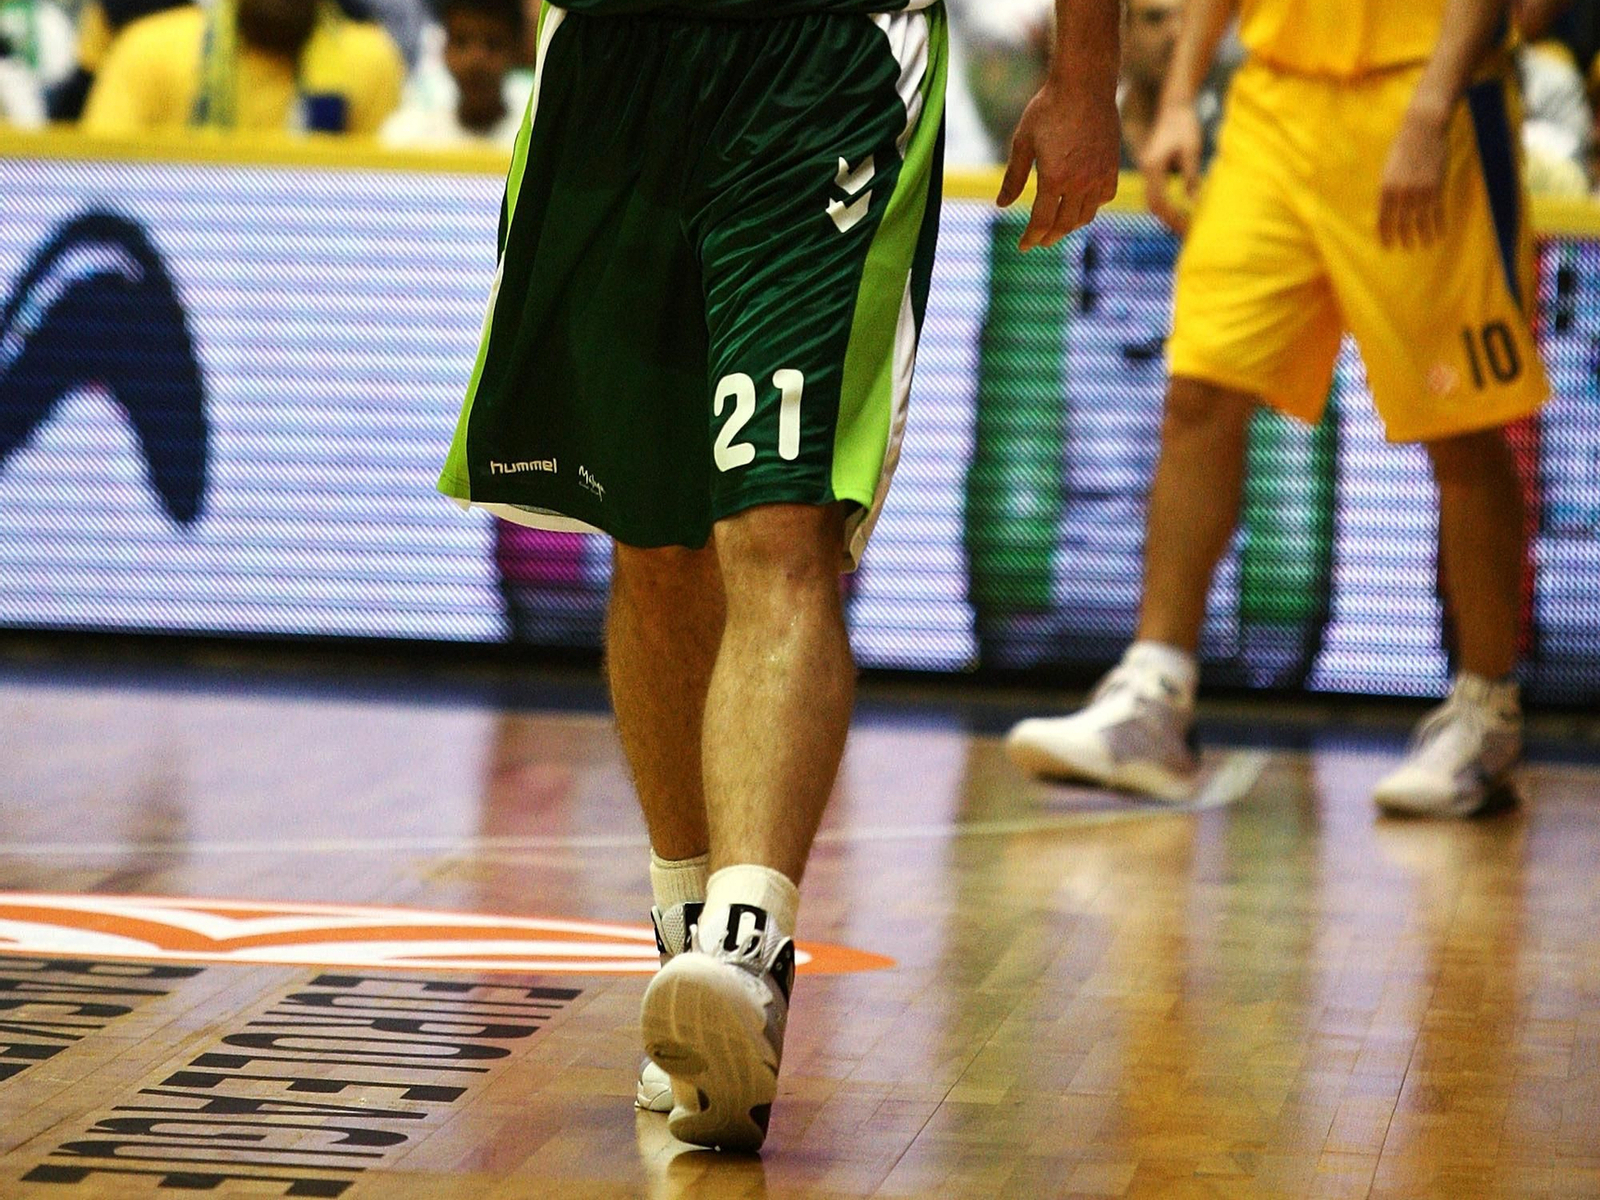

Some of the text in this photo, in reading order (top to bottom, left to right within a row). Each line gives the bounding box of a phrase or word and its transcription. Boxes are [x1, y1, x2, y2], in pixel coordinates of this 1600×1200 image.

[1461, 320, 1522, 392] 10
[713, 368, 805, 473] 21
[489, 457, 558, 475] hummel
[20, 973, 585, 1199] EUROLEAGUE
